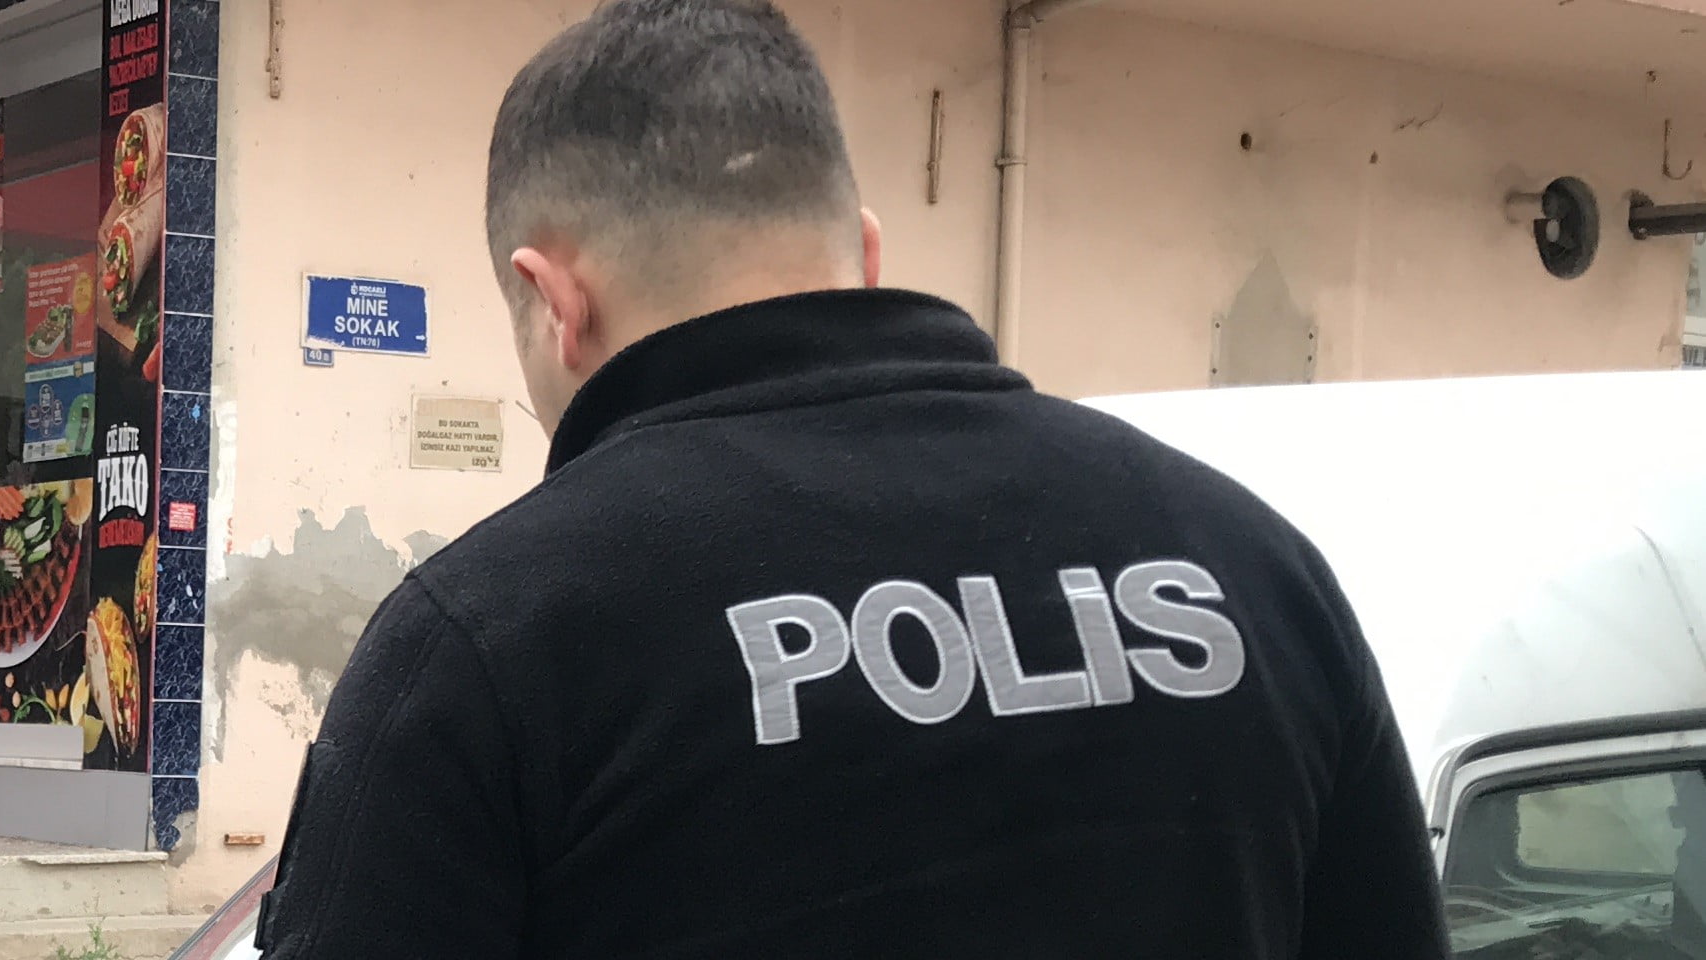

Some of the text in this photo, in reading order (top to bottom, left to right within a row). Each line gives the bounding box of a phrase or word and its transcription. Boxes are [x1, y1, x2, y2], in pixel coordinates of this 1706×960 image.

[346, 296, 389, 317] MİNE
[334, 315, 400, 338] SOKAK
[438, 419, 480, 429] BU SOKAKTA
[417, 430, 453, 440] DOĞALGAZ
[454, 432, 473, 441] HATTI
[445, 444, 462, 452] KAZI
[97, 453, 148, 522] TAKO
[726, 560, 1245, 746] POLİS
